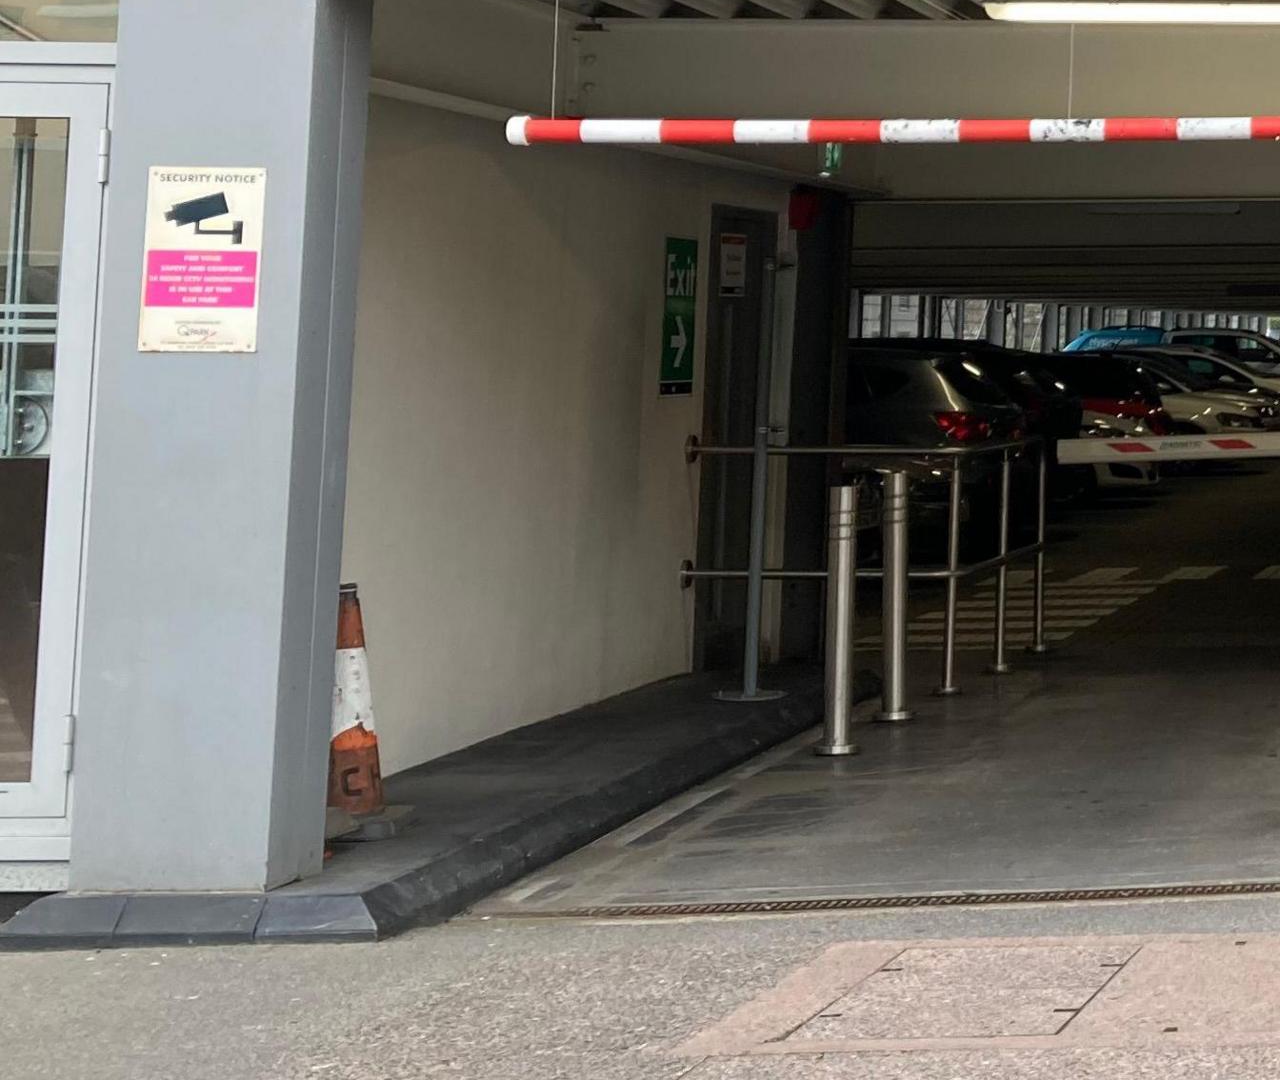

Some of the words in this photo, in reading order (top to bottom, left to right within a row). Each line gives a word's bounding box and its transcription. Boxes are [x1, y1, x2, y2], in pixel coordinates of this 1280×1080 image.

[159, 172, 212, 183] SECURITY
[214, 173, 257, 184] NOTICE
[666, 253, 695, 296] Exit
